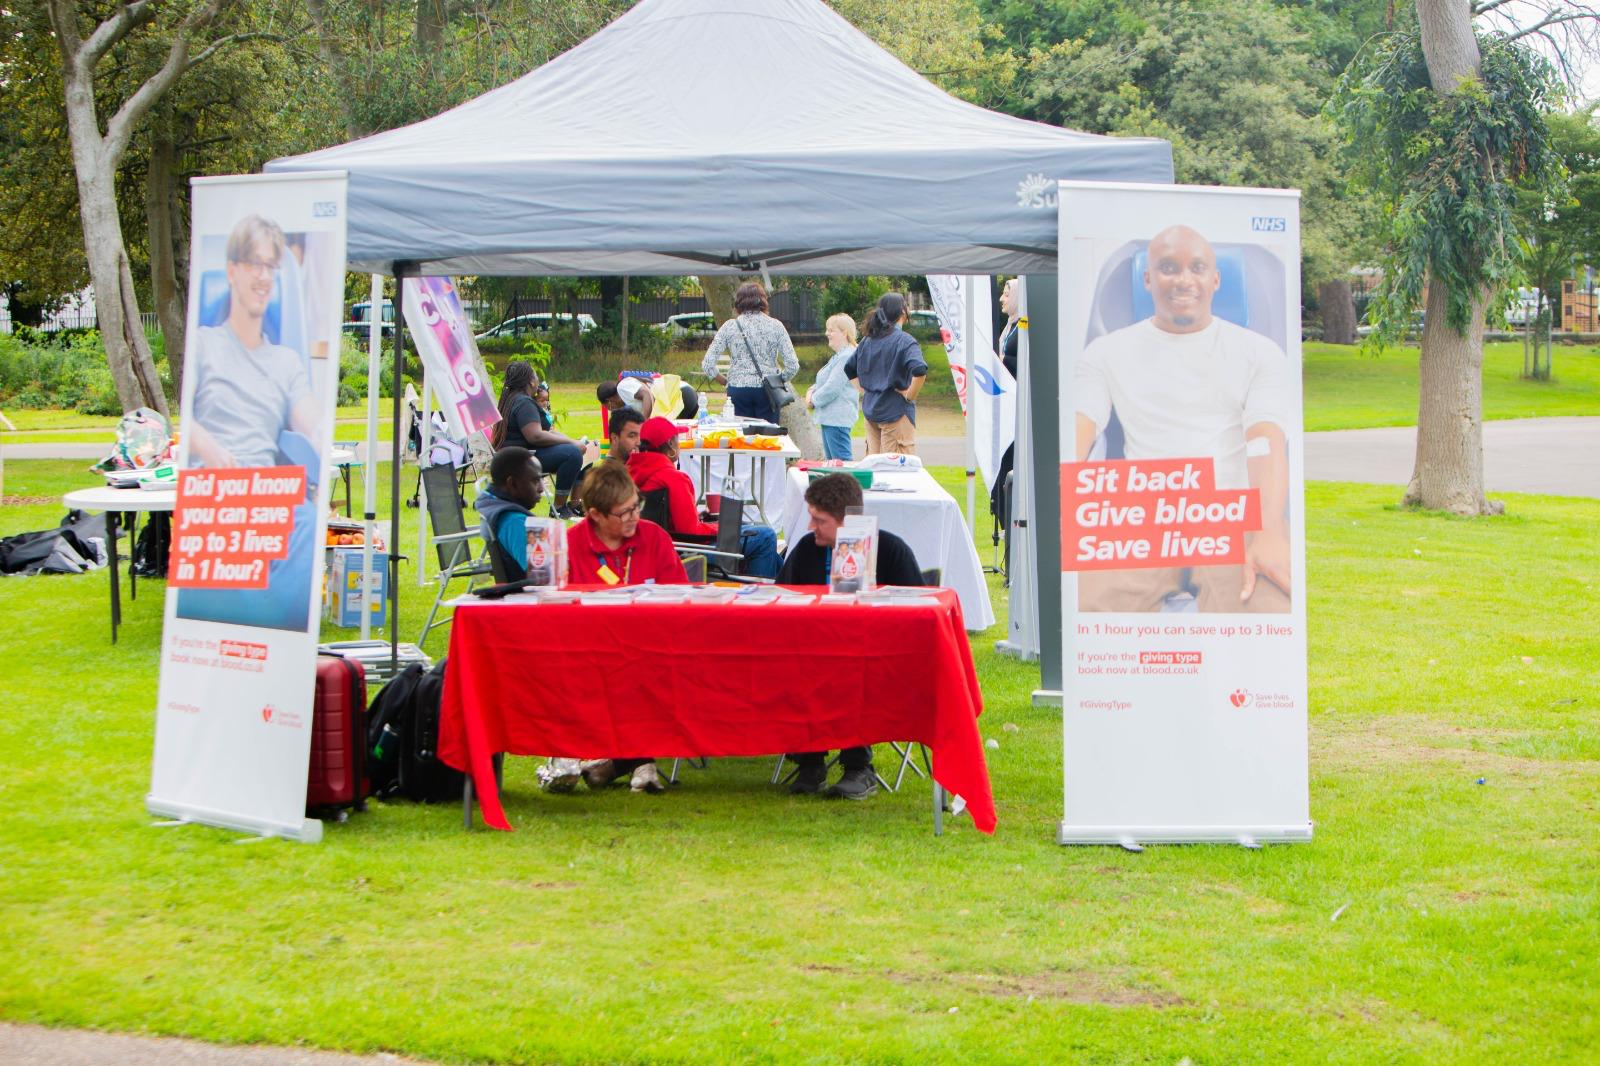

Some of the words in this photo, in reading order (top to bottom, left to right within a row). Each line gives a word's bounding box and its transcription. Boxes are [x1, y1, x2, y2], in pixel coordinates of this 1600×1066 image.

[1253, 217, 1286, 231] NHS
[182, 474, 215, 496] Did
[214, 479, 249, 502] you
[251, 472, 301, 495] know
[1076, 467, 1119, 494] Sit
[1126, 464, 1201, 492] back
[180, 507, 215, 530] you
[218, 507, 247, 524] can
[250, 507, 289, 524] save
[1076, 501, 1146, 527] Give
[1154, 496, 1246, 524] blood
[180, 536, 204, 558] up
[206, 532, 226, 552] to
[228, 531, 241, 552] 3
[243, 530, 283, 552] lives
[1077, 536, 1150, 561] Save
[1160, 530, 1230, 558] lives
[176, 558, 195, 580] in
[200, 560, 210, 580] 1
[212, 558, 264, 580] hour?
[1078, 624, 1089, 634] In
[1094, 624, 1100, 634] 1
[1105, 624, 1133, 634] hour
[1137, 626, 1160, 637] you
[1164, 626, 1185, 635] can
[1189, 626, 1216, 635] save
[1220, 626, 1235, 637] up
[1240, 625, 1252, 635] to
[1255, 625, 1263, 635] 3
[1266, 624, 1293, 635] lives
[1078, 652, 1085, 661] If
[1088, 653, 1117, 662] you're
[1121, 652, 1136, 661] the
[1142, 653, 1173, 664] giving
[1175, 653, 1199, 664] type
[1078, 666, 1103, 674] book
[1143, 666, 1199, 674] blood.co.uk
[1080, 701, 1132, 710] #GivingType
[1274, 701, 1294, 709] blood
